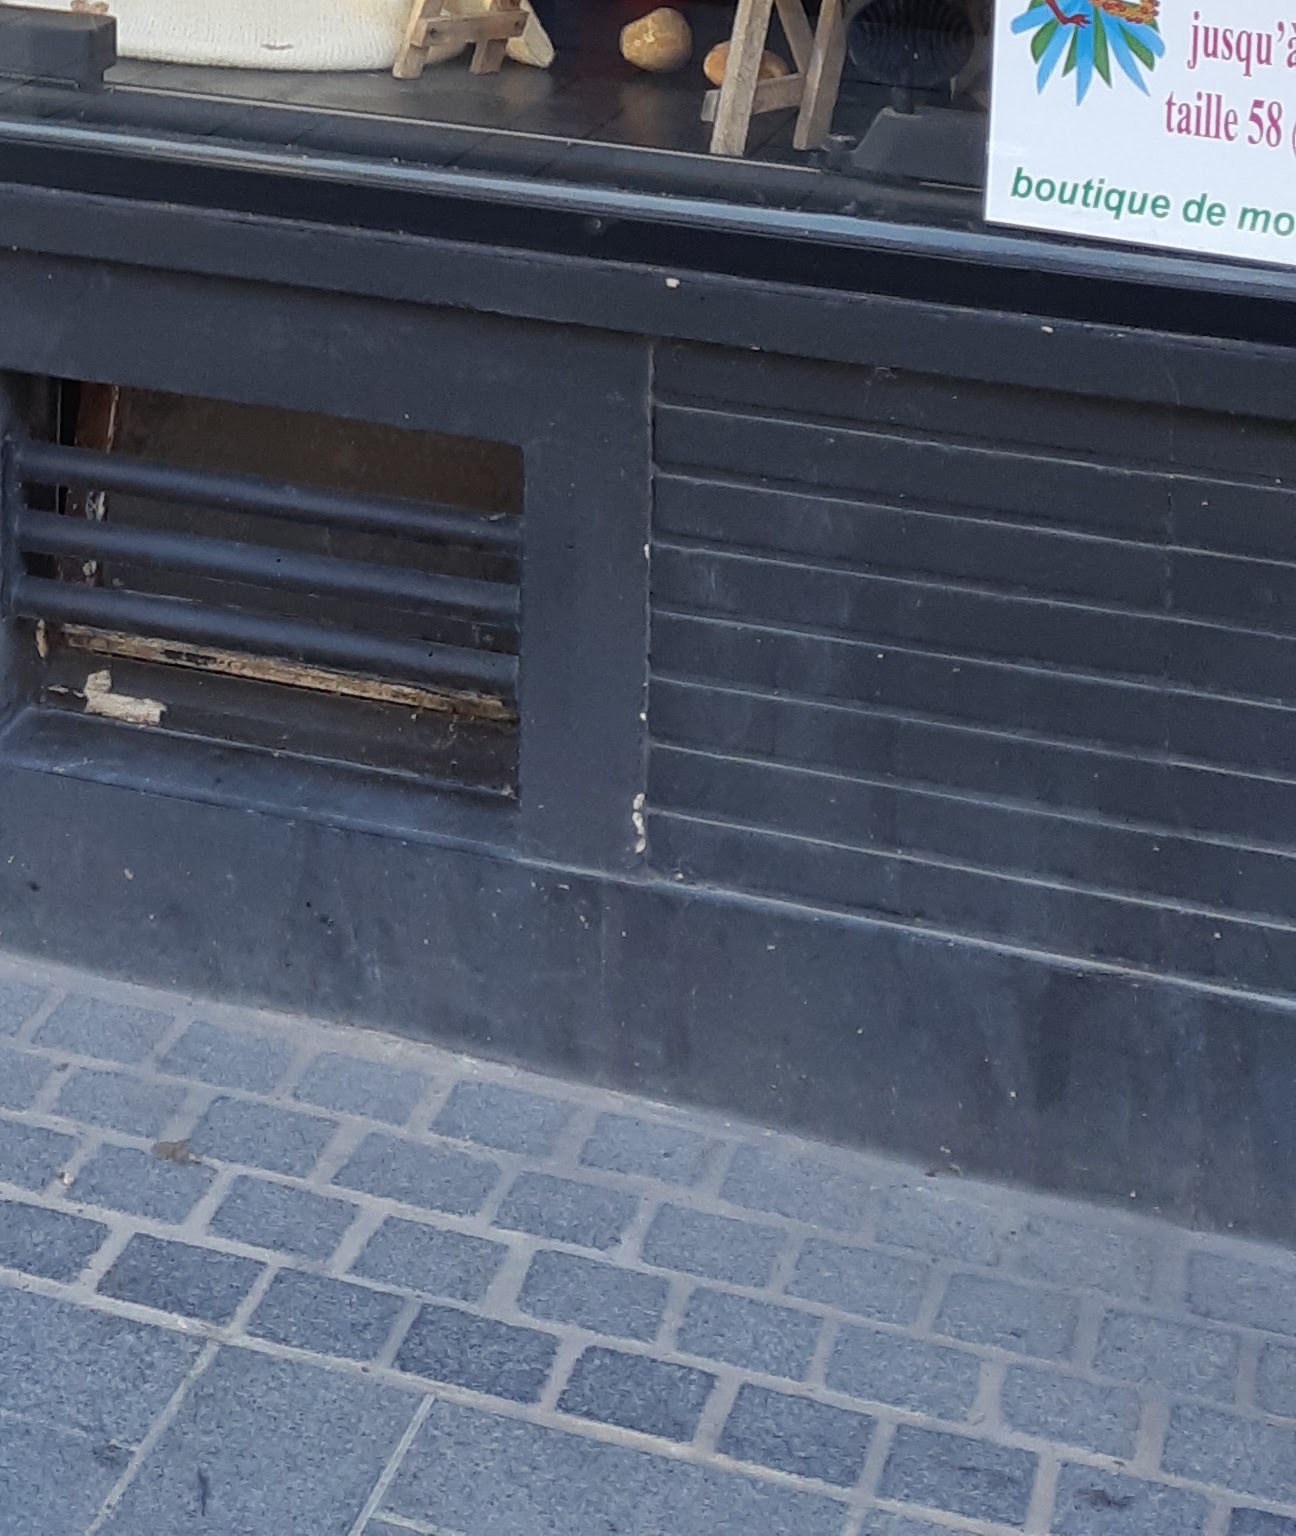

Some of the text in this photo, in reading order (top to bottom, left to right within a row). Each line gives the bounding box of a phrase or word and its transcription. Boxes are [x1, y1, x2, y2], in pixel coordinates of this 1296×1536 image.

[1165, 90, 1239, 142] taille
[1247, 99, 1283, 148] 58
[1010, 166, 1171, 221] boutique
[1182, 193, 1226, 227] de
